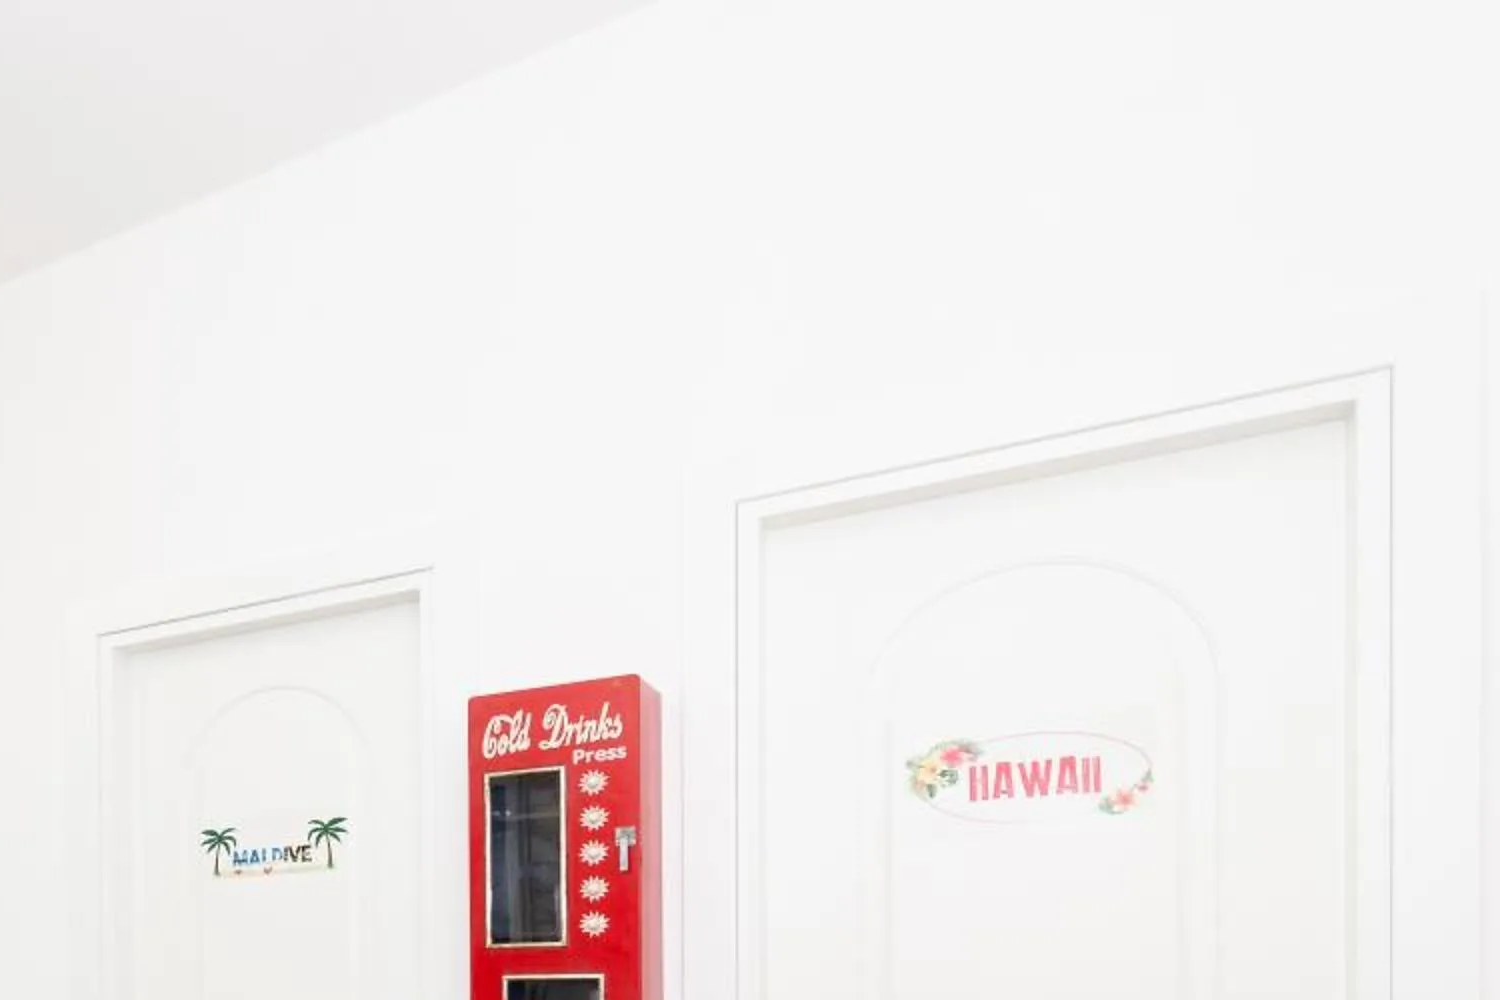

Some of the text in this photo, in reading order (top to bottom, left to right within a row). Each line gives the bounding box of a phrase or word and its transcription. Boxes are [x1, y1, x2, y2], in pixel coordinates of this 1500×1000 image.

[482, 701, 623, 759] Cold Drinks
[572, 746, 627, 765] Press
[968, 755, 1103, 802] HAWAII
